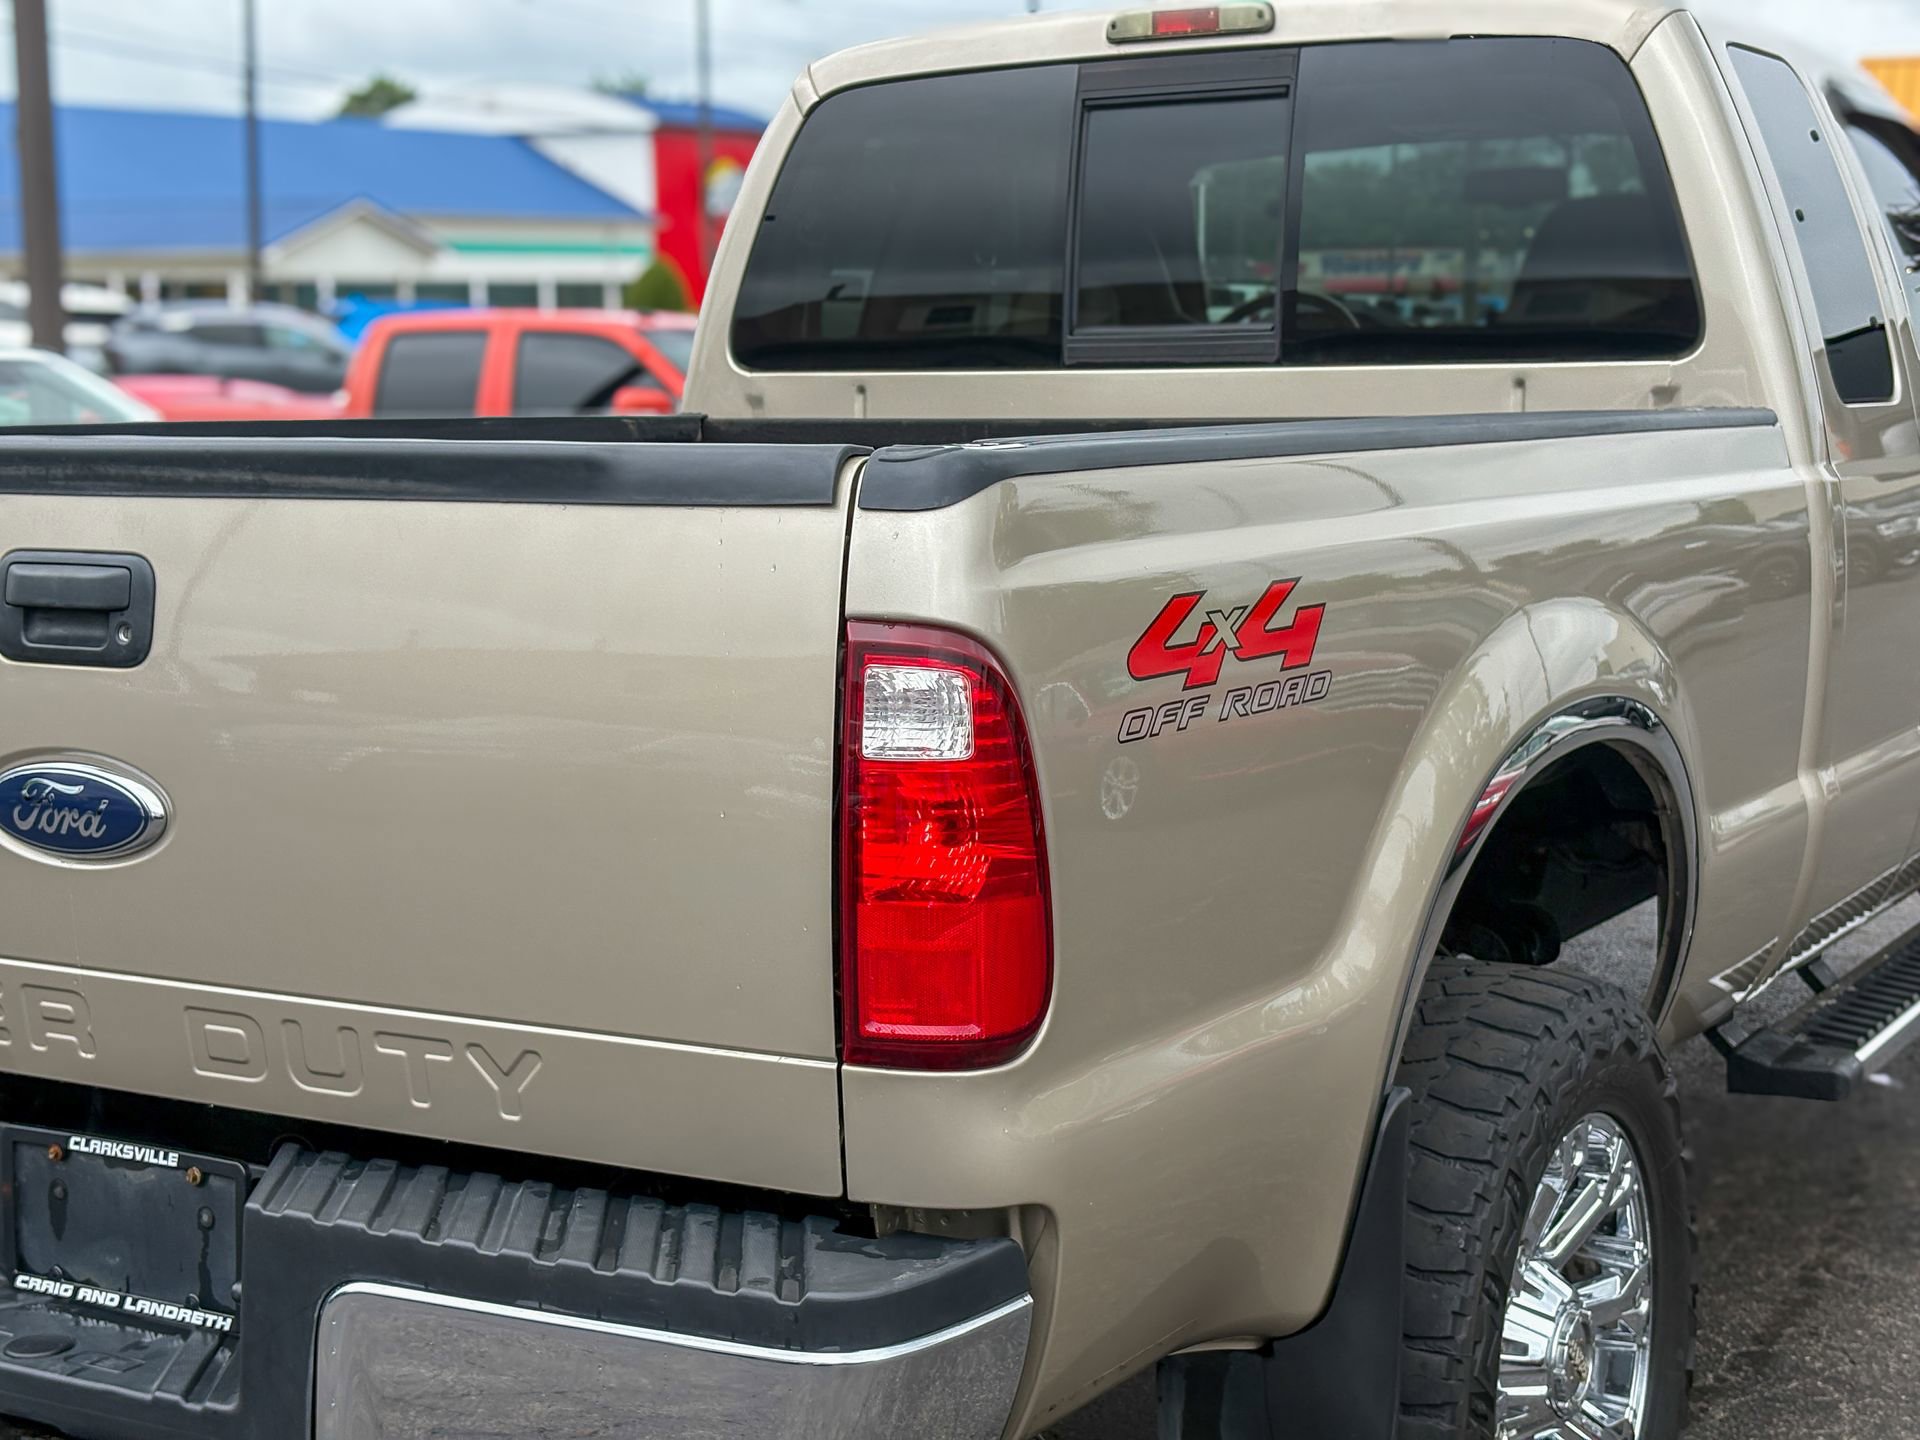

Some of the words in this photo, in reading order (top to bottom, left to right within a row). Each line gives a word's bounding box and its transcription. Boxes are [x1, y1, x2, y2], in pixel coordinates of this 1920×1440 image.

[1117, 694, 1211, 744] OFF
[1218, 669, 1332, 722] ROAD
[13, 777, 108, 839] Ford
[0, 980, 97, 1059] R
[183, 1005, 543, 1121] DUTY
[68, 1136, 179, 1167] CLARKSVILLE
[14, 1274, 74, 1298] CRAIG
[77, 1287, 119, 1308] AND
[123, 1296, 233, 1331] LANDRETH
